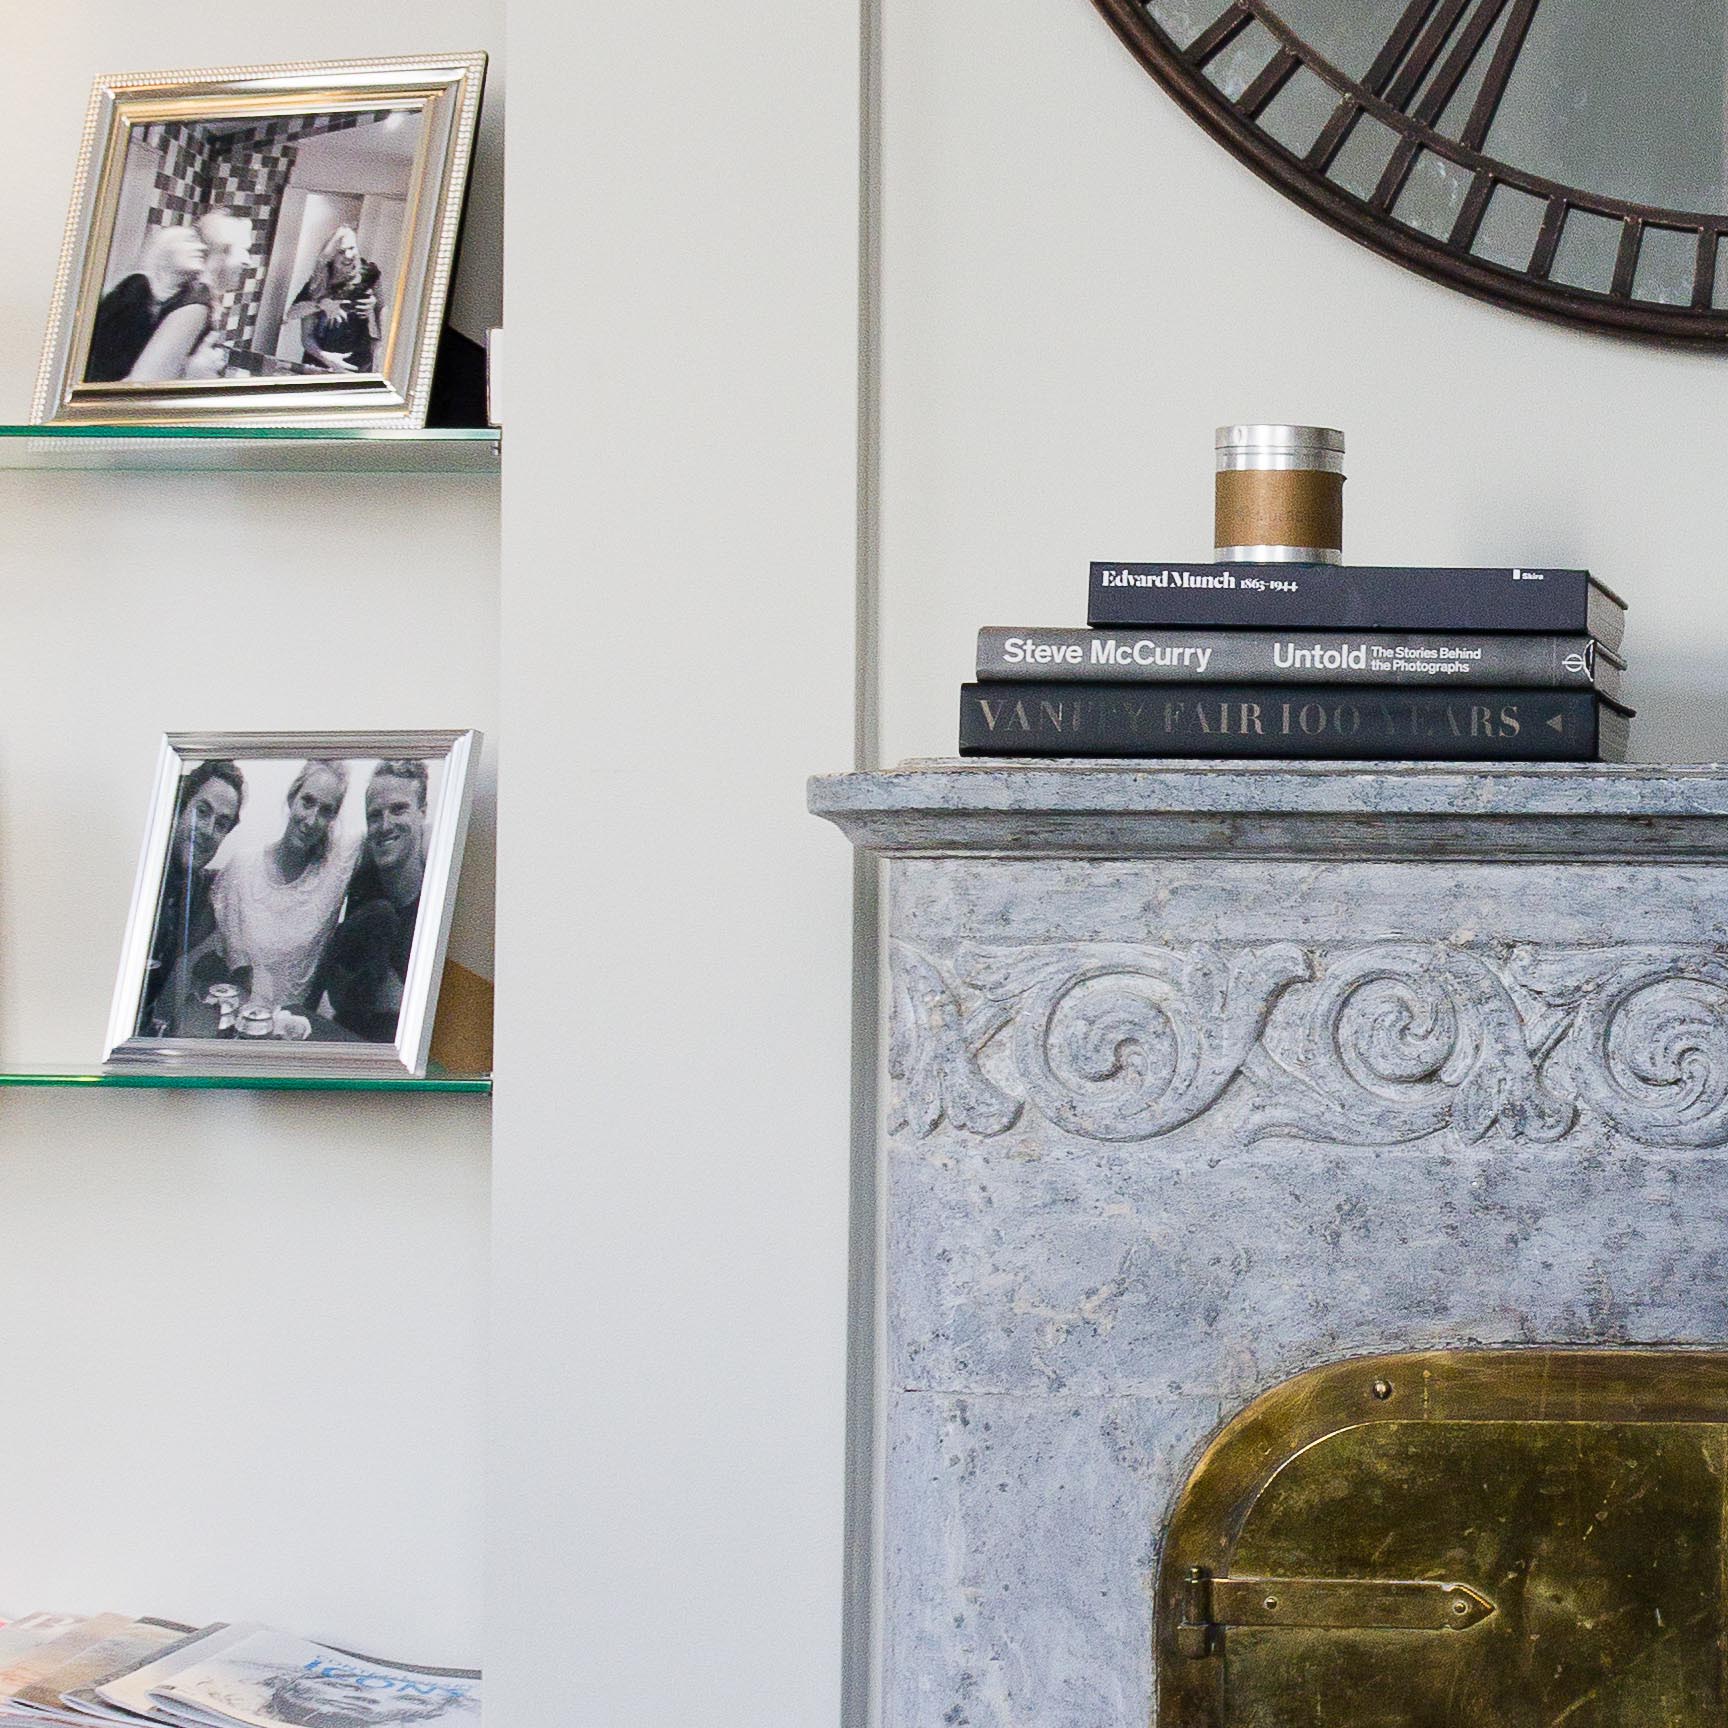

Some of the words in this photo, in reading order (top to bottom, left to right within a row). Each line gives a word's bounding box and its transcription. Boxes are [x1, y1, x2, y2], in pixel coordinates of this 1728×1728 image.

[1101, 569, 1169, 588] Edvard
[1169, 571, 1236, 589] Munch
[1002, 637, 1083, 665] Steve
[1090, 639, 1212, 672] McCurry
[1273, 642, 1366, 670] Untold
[1371, 646, 1394, 658] The
[1395, 646, 1438, 659] Stories
[1439, 647, 1482, 660] Behind
[1371, 659, 1392, 671] the
[1392, 659, 1470, 675] Photographs
[975, 699, 1146, 733] VANIY
[1163, 701, 1266, 735] FAIR
